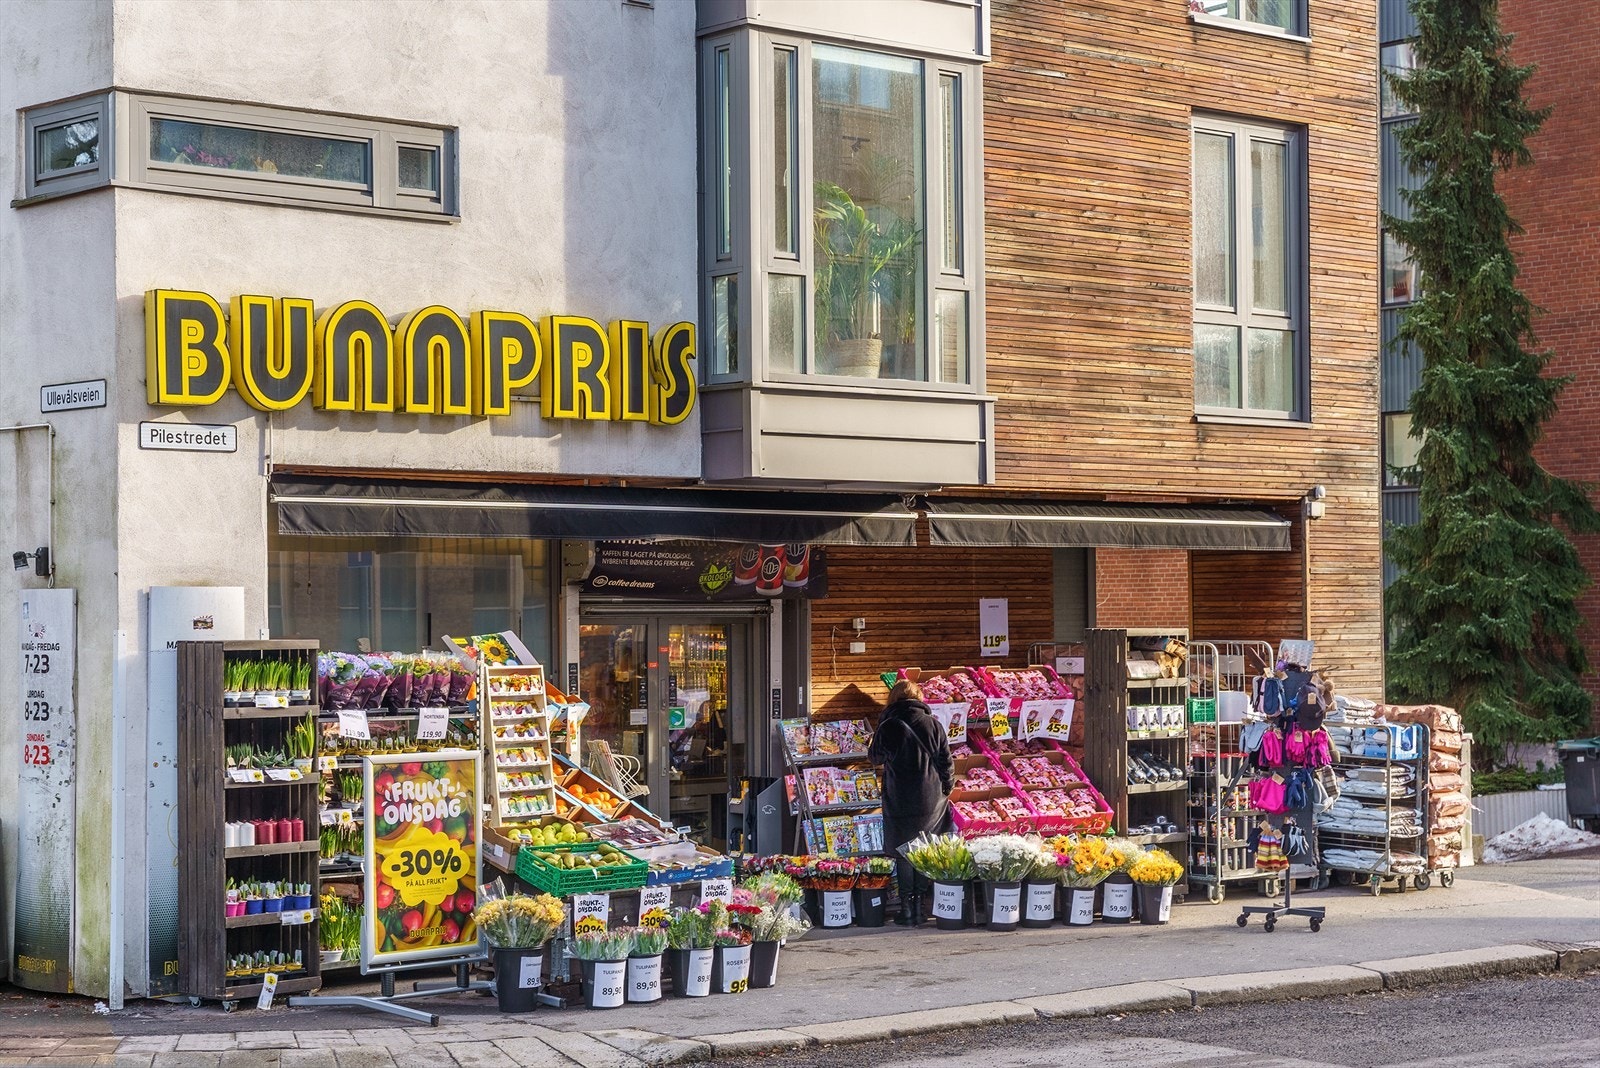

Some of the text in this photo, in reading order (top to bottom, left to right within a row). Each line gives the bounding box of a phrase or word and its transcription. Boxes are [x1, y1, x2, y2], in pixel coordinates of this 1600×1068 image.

[145, 288, 697, 425] BUNNPRIS
[46, 387, 100, 406] Ullevålsveien
[150, 428, 227, 446] Pilestredet
[649, 550, 656, 558] PÅ
[654, 559, 663, 567] OG
[608, 579, 655, 589] coffee dreams
[25, 654, 50, 674] 7-23
[27, 690, 45, 699] LØRDAG
[24, 702, 50, 721] 8-23
[26, 733, 45, 742] SØNDAG
[422, 730, 442, 738] 119,90
[24, 745, 50, 765] 8-23
[391, 777, 456, 803] FRUKT-
[383, 798, 461, 825] ONSDAG
[391, 847, 461, 878] -30%
[406, 877, 415, 888] PÅ
[414, 878, 426, 887] ALL
[937, 902, 956, 912] 99,90
[1000, 905, 1017, 913] 79,90
[1033, 904, 1051, 912] 79,90
[1109, 904, 1128, 912] 59,90
[830, 913, 848, 921] 79,90
[526, 977, 541, 986] 89,9
[636, 980, 658, 991] 89,90
[602, 986, 622, 996] 89,90
